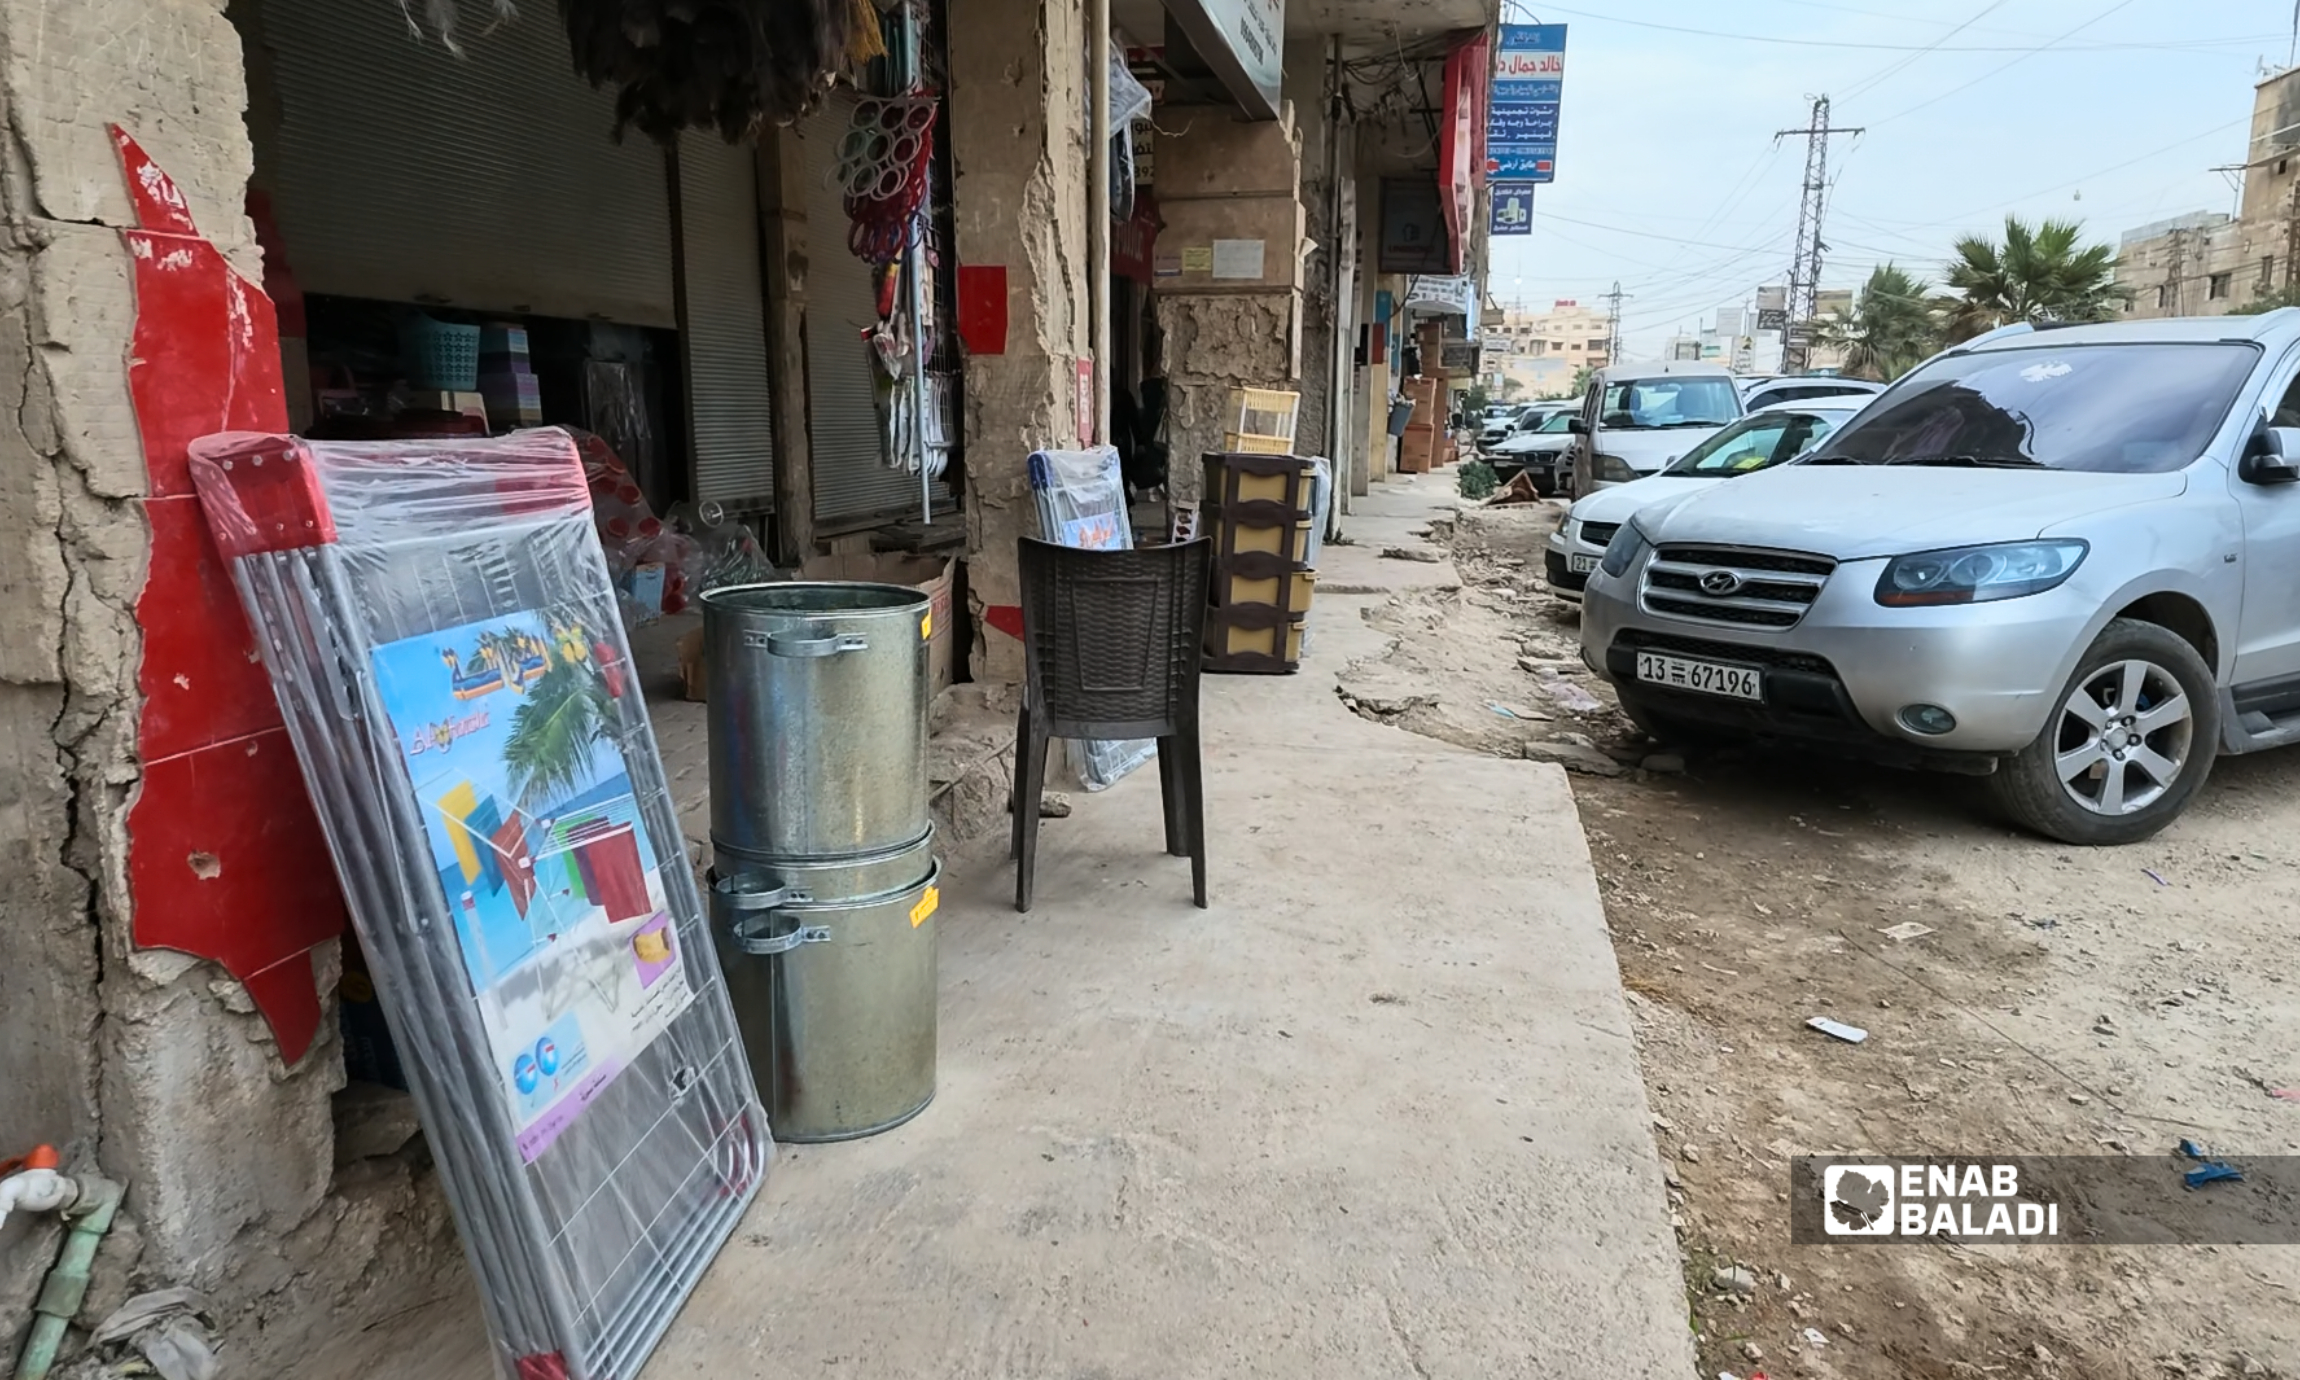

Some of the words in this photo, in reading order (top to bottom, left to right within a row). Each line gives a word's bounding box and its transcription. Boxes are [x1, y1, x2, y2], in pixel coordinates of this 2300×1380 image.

[1508, 54, 1537, 76] جمال
[1539, 54, 1562, 72] خالد
[1507, 120, 1524, 128] وجه
[1525, 117, 1553, 128] جراحة
[1643, 657, 1665, 682] 13
[1690, 664, 1753, 696] 67196
